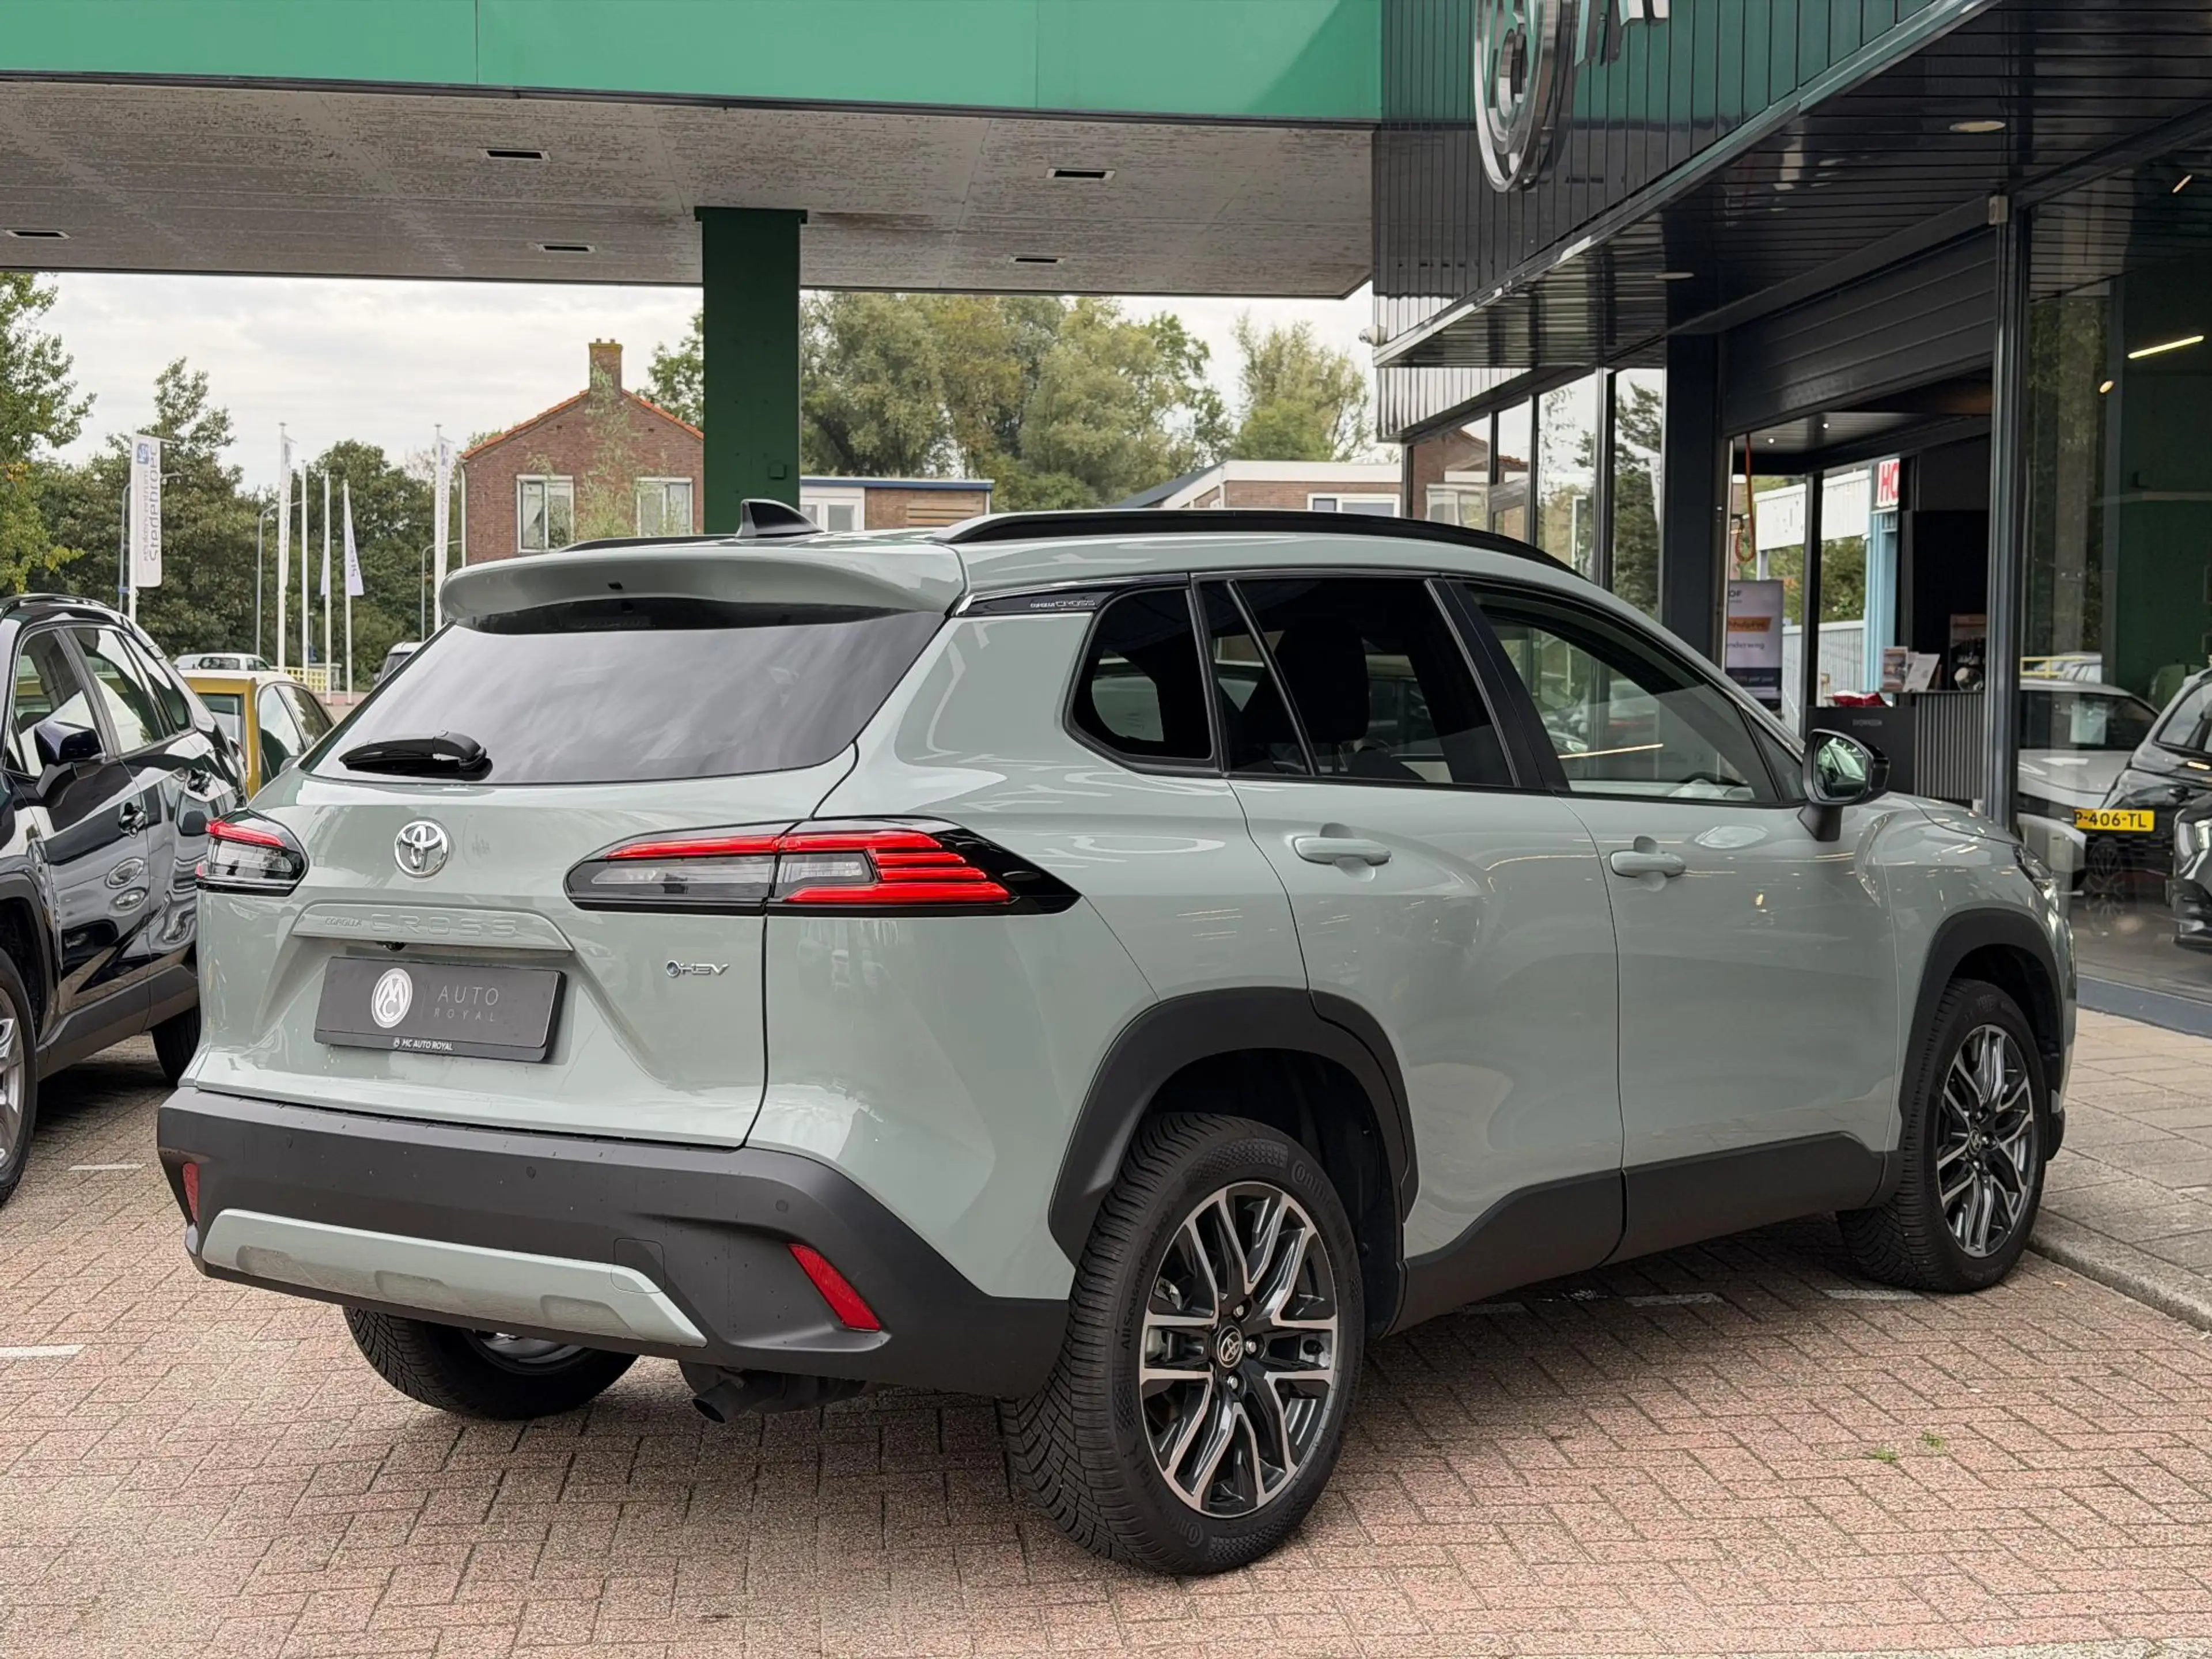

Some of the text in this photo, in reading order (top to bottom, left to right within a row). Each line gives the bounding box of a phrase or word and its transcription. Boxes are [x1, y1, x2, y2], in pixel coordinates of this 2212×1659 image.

[2074, 811, 2147, 828] P-406-TL
[371, 913, 517, 938] CROSS
[437, 984, 499, 1006] AUTO
[434, 1007, 496, 1022] ROYAL
[402, 1039, 454, 1051] MC AUTO ROYAL
